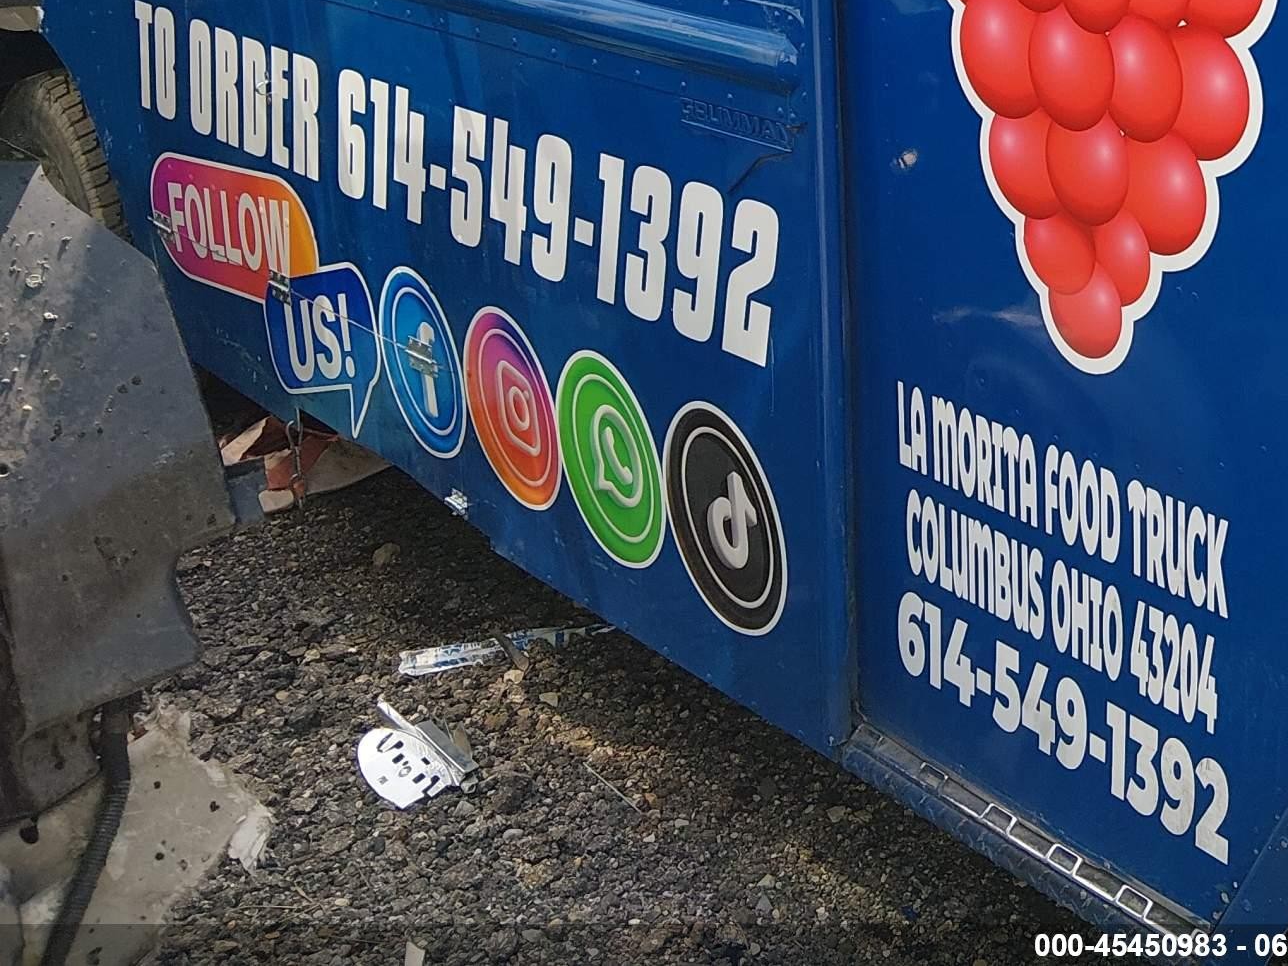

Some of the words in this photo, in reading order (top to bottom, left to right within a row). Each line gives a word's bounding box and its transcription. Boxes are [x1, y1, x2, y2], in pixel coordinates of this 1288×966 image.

[135, 0, 176, 120] TO
[189, 19, 320, 182] ORDER
[338, 68, 779, 366] 614-549-1392
[167, 181, 291, 277] FOLLOW
[283, 292, 357, 383] US!
[897, 380, 928, 476] LA
[931, 395, 1039, 528] MORITA
[1045, 444, 1121, 564] FOOD
[1127, 479, 1229, 619] TRUCK
[906, 489, 1046, 640] COLUMBUS
[1051, 559, 1123, 682] OHIO
[1130, 600, 1218, 734] 43204
[897, 591, 1230, 866] 614-549-1392
